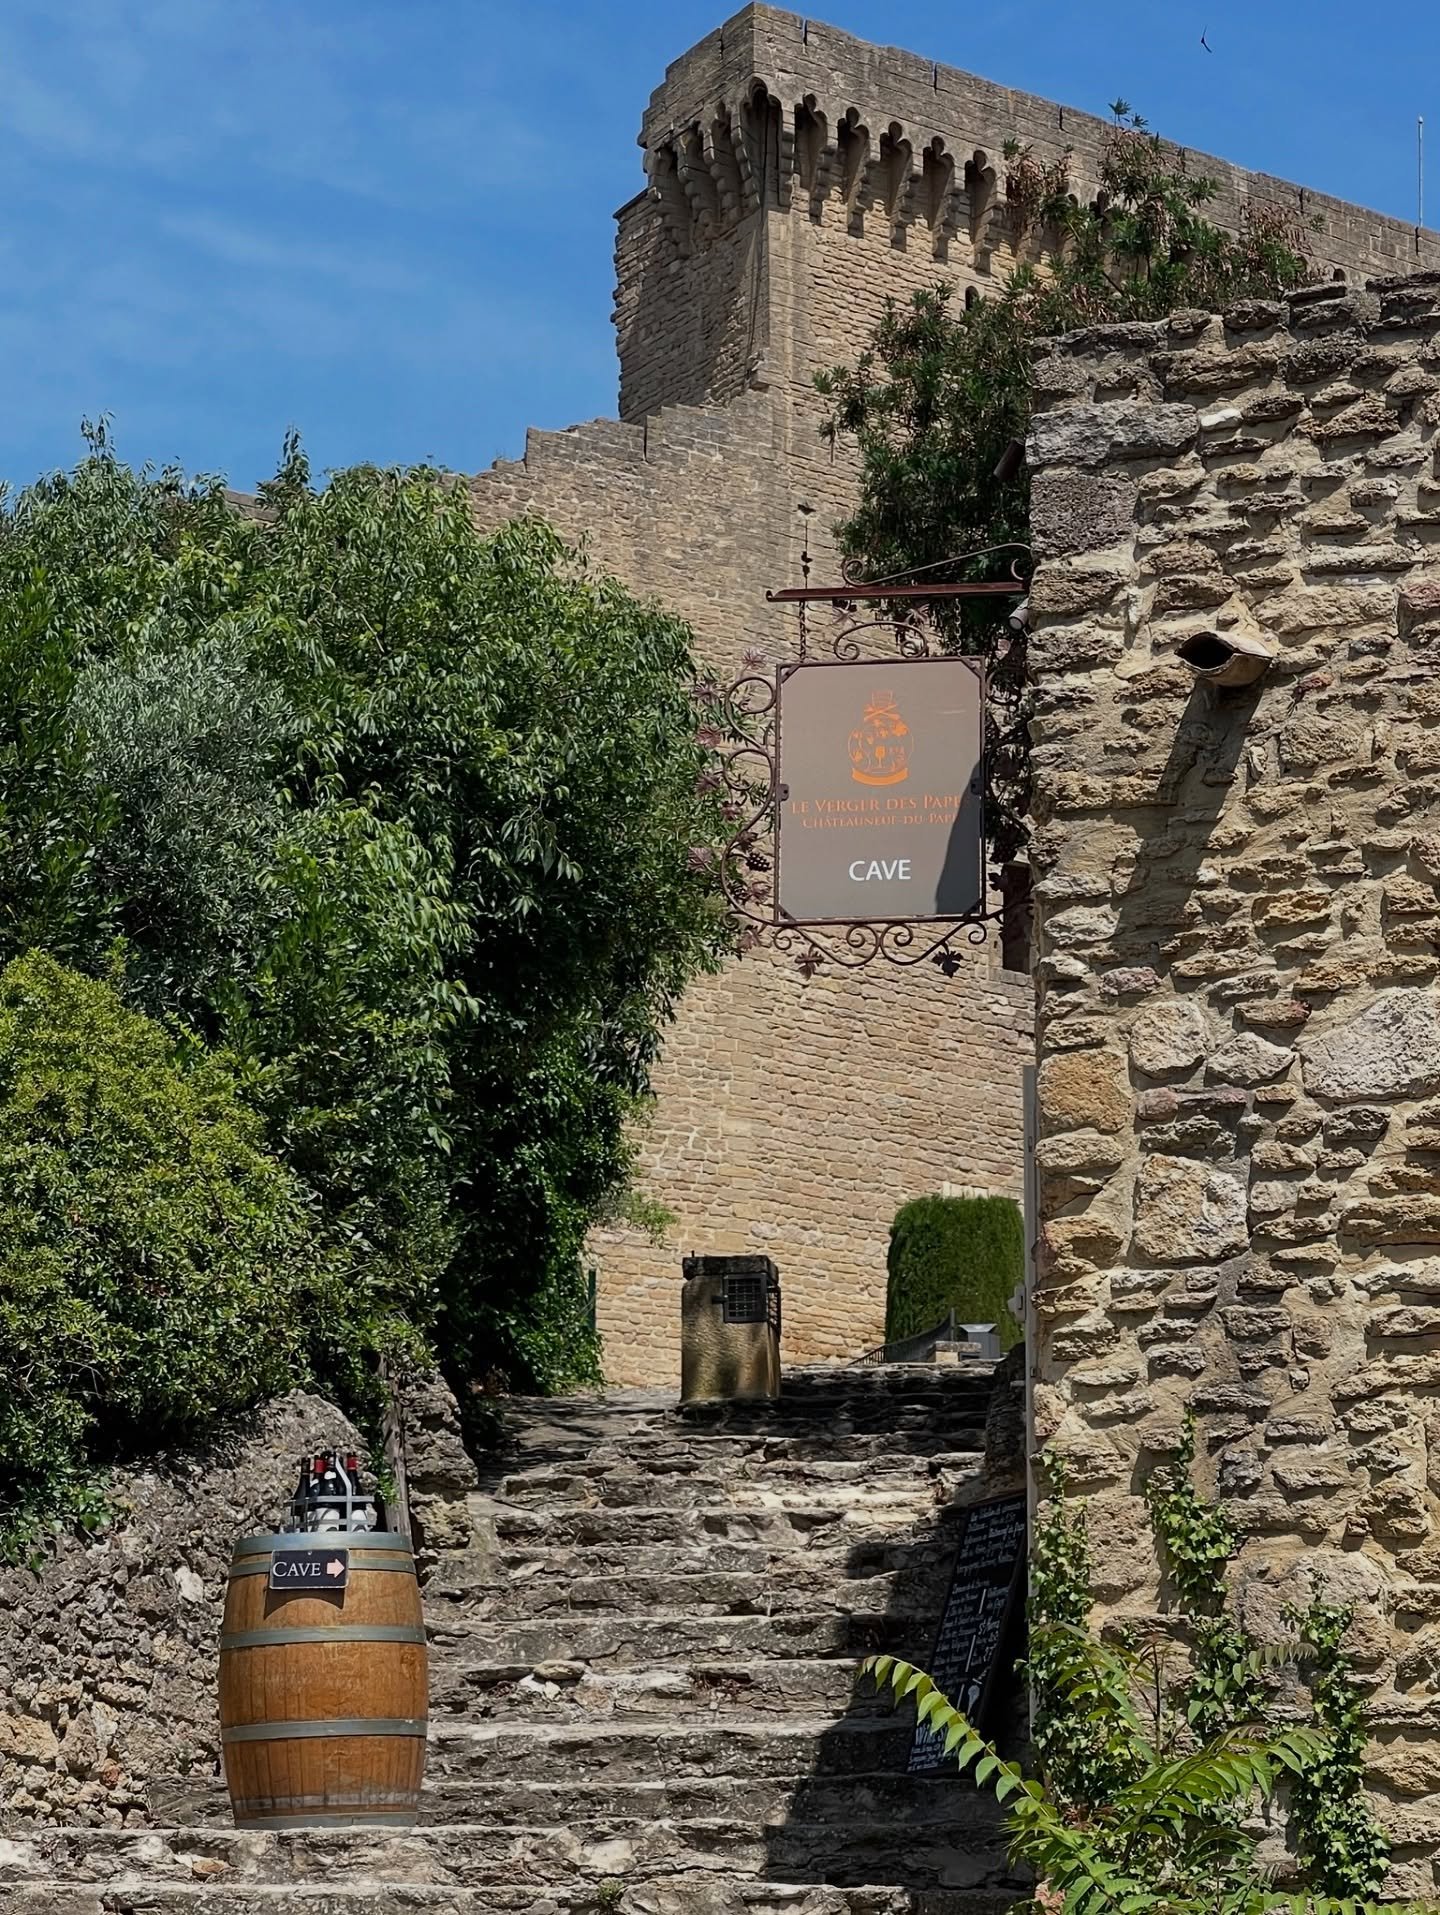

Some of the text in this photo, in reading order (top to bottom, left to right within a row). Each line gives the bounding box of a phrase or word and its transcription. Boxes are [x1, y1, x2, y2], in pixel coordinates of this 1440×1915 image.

[791, 801, 809, 814] LE
[814, 797, 880, 813] VERGER
[886, 797, 917, 810] DES
[849, 859, 911, 881] CAVE
[272, 1561, 321, 1577] CAVE
